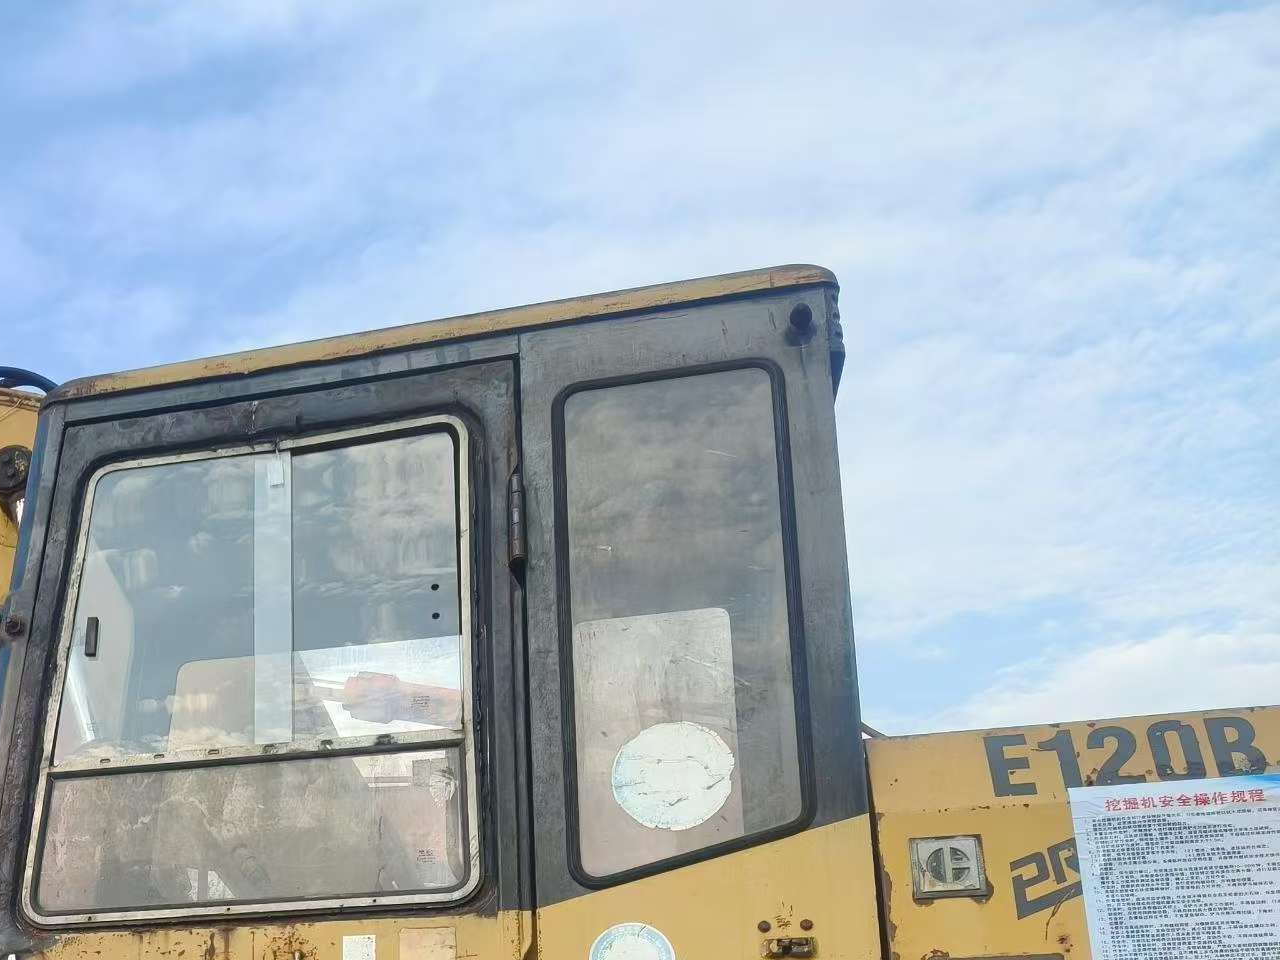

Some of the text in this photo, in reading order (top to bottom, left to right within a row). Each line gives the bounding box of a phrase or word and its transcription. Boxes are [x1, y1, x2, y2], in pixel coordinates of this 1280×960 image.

[983, 716, 1267, 797] E120B
[1104, 788, 1266, 811] 挖掘机安全操作规程
